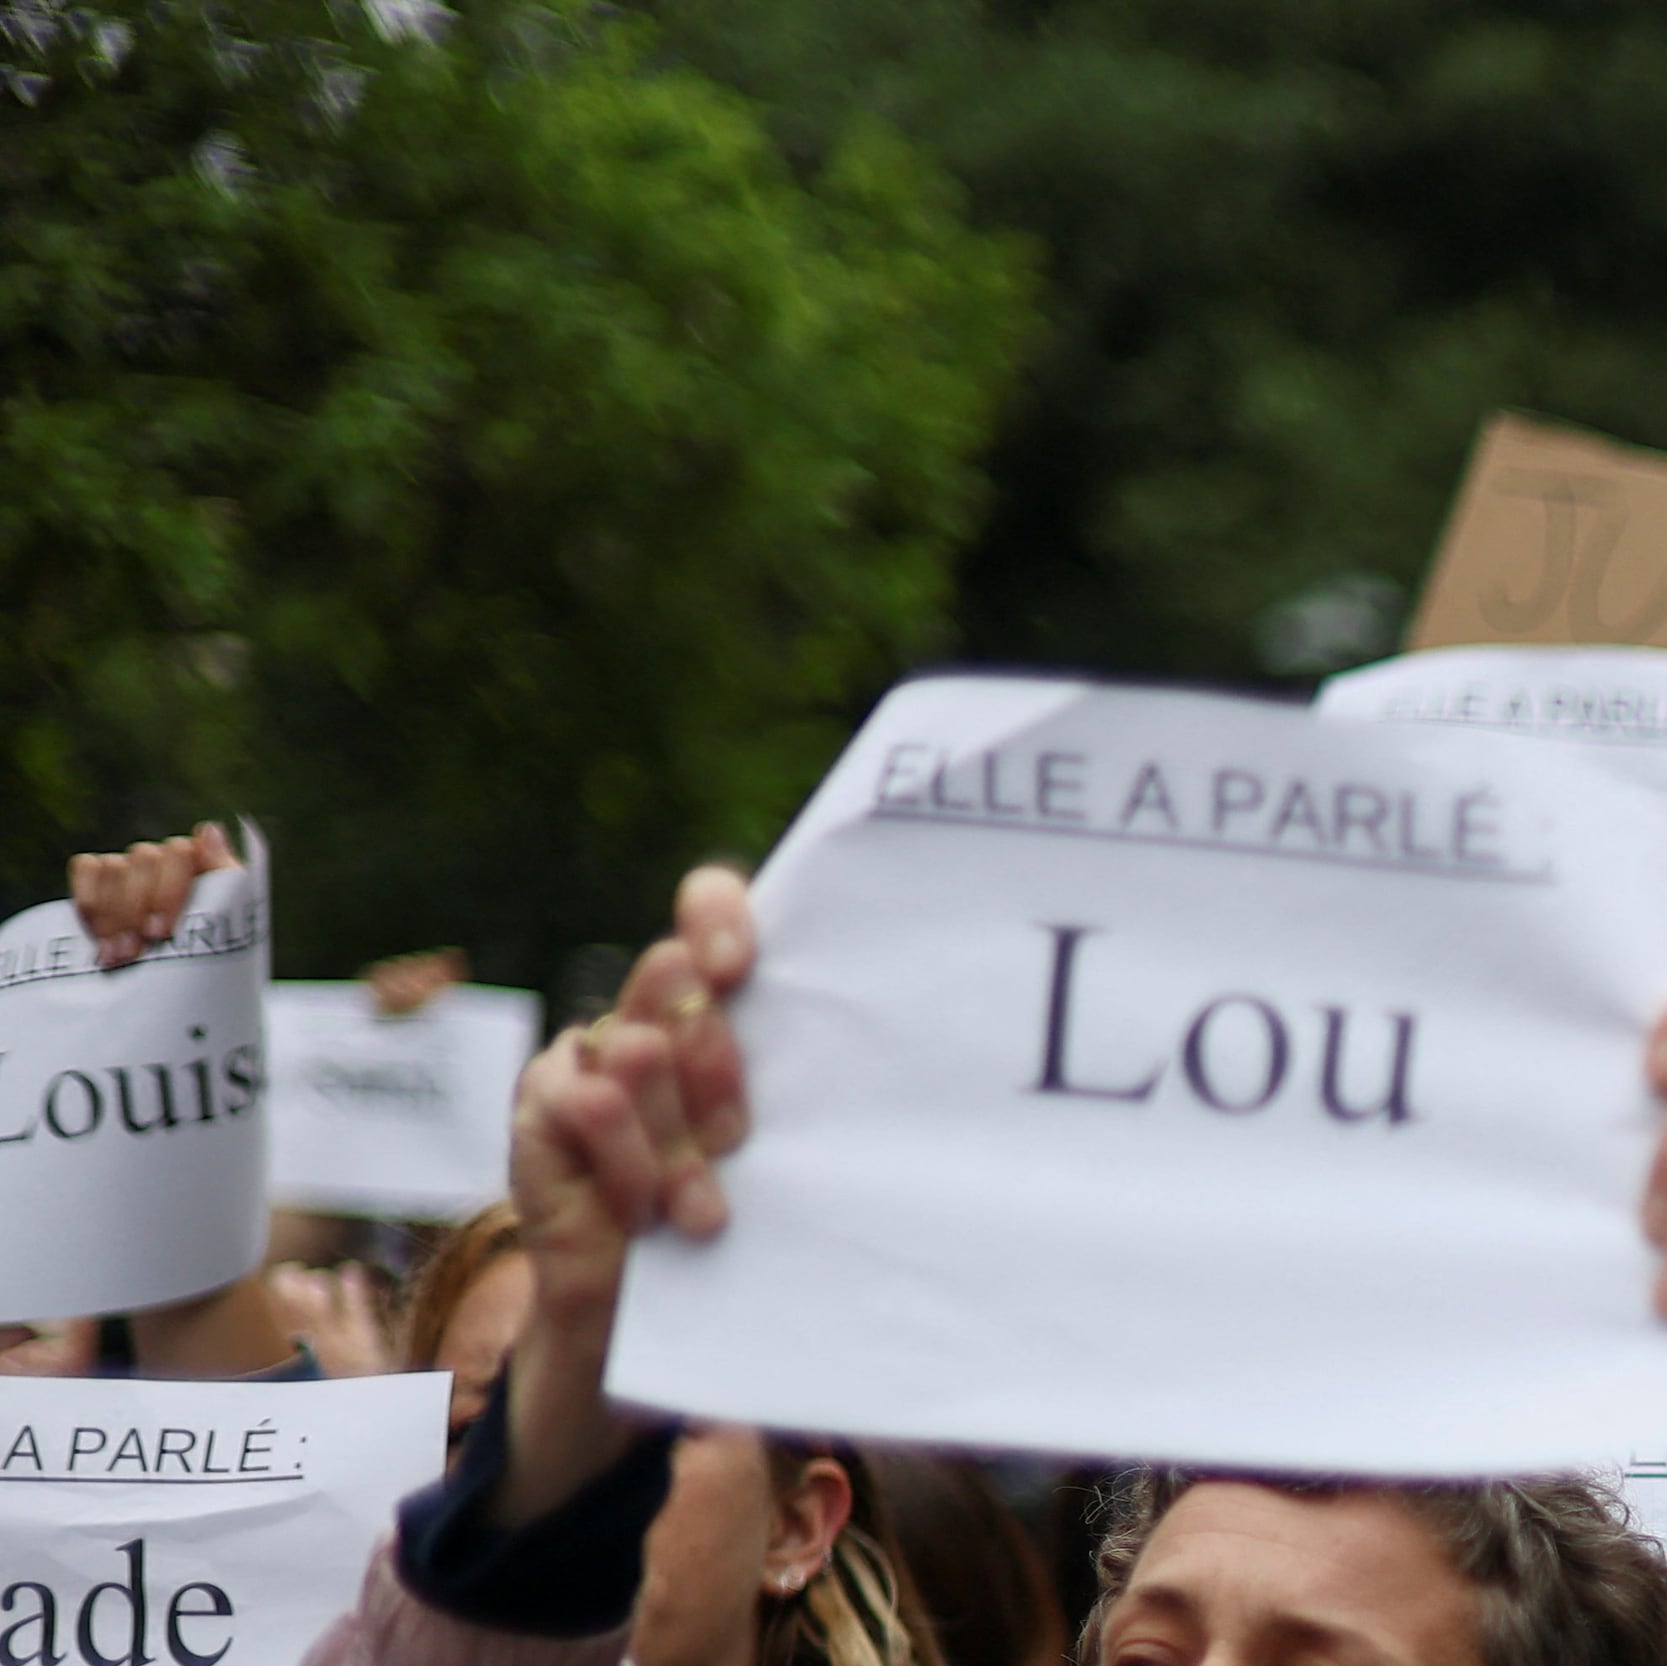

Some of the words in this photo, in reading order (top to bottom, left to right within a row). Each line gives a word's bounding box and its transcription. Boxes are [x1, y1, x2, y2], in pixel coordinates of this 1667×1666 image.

[876, 742, 1086, 820] ELLE
[1119, 760, 1181, 833] A
[1211, 766, 1507, 862] PARLÉ
[1021, 921, 1424, 1128] Lou
[2, 1425, 44, 1472] A
[66, 1419, 279, 1475] PARLÉ
